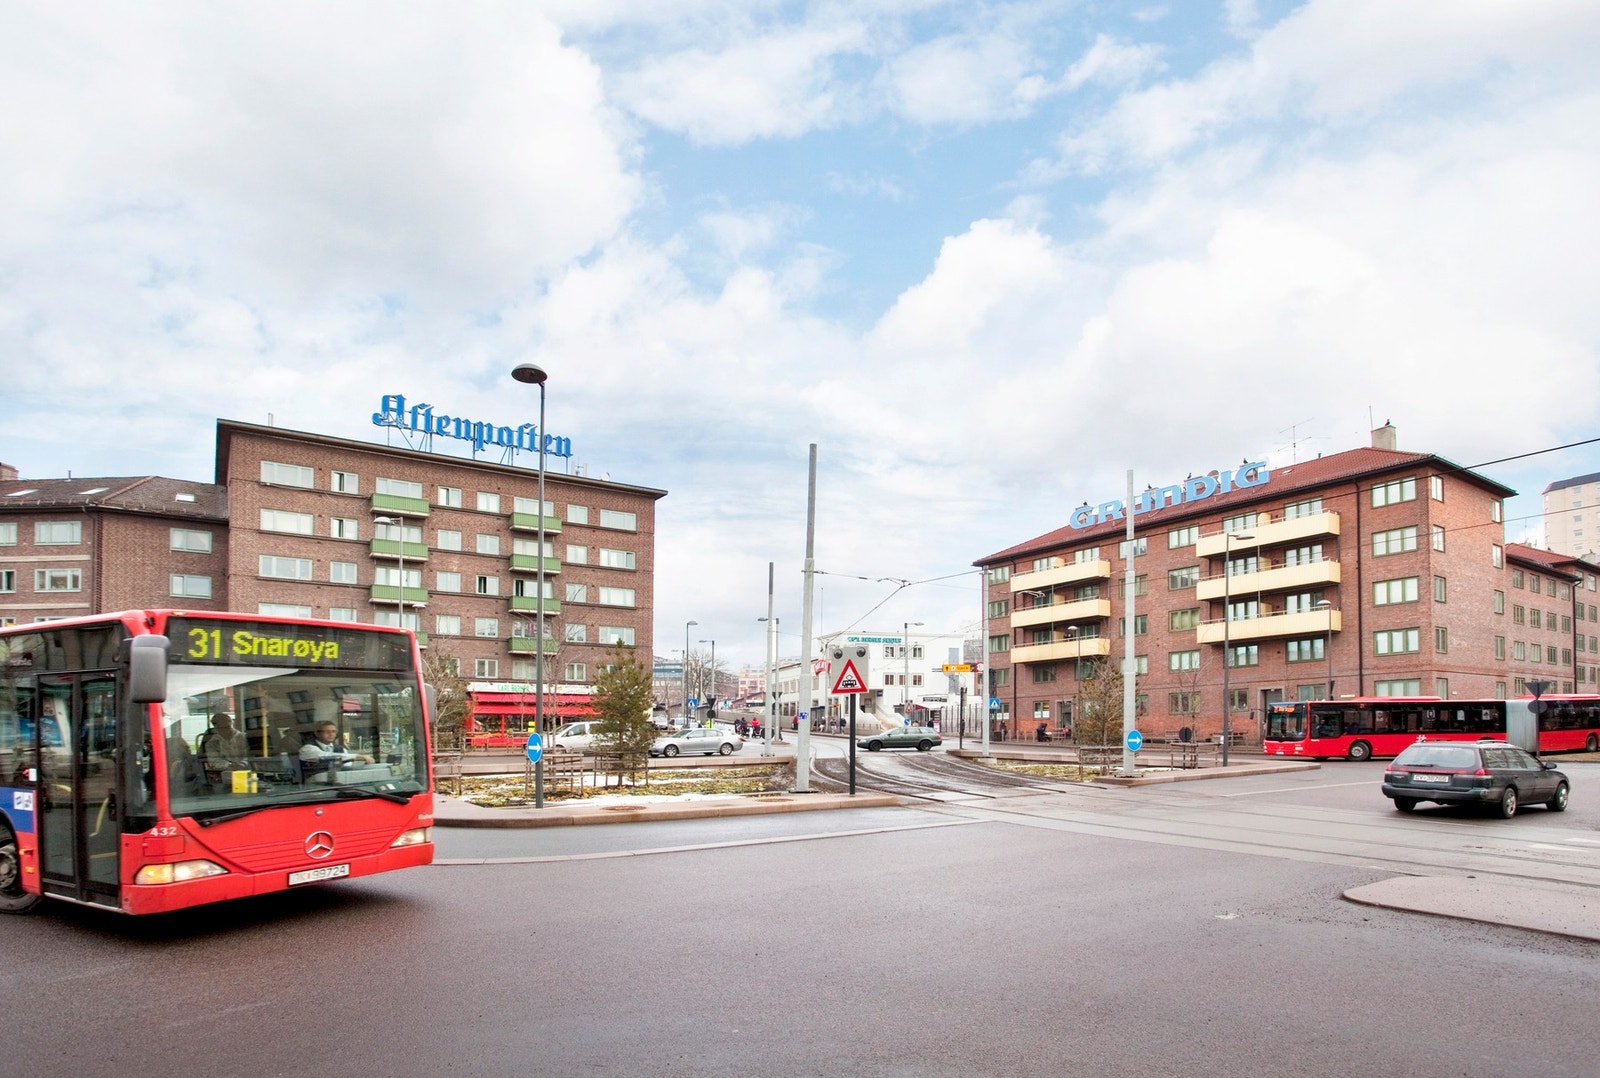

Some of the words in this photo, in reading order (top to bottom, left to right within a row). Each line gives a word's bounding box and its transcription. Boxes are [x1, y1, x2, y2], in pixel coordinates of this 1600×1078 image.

[1069, 461, 1270, 530] GRUNDIG
[188, 628, 222, 659] 31
[232, 630, 339, 663] Snarøya
[149, 826, 177, 836] 432
